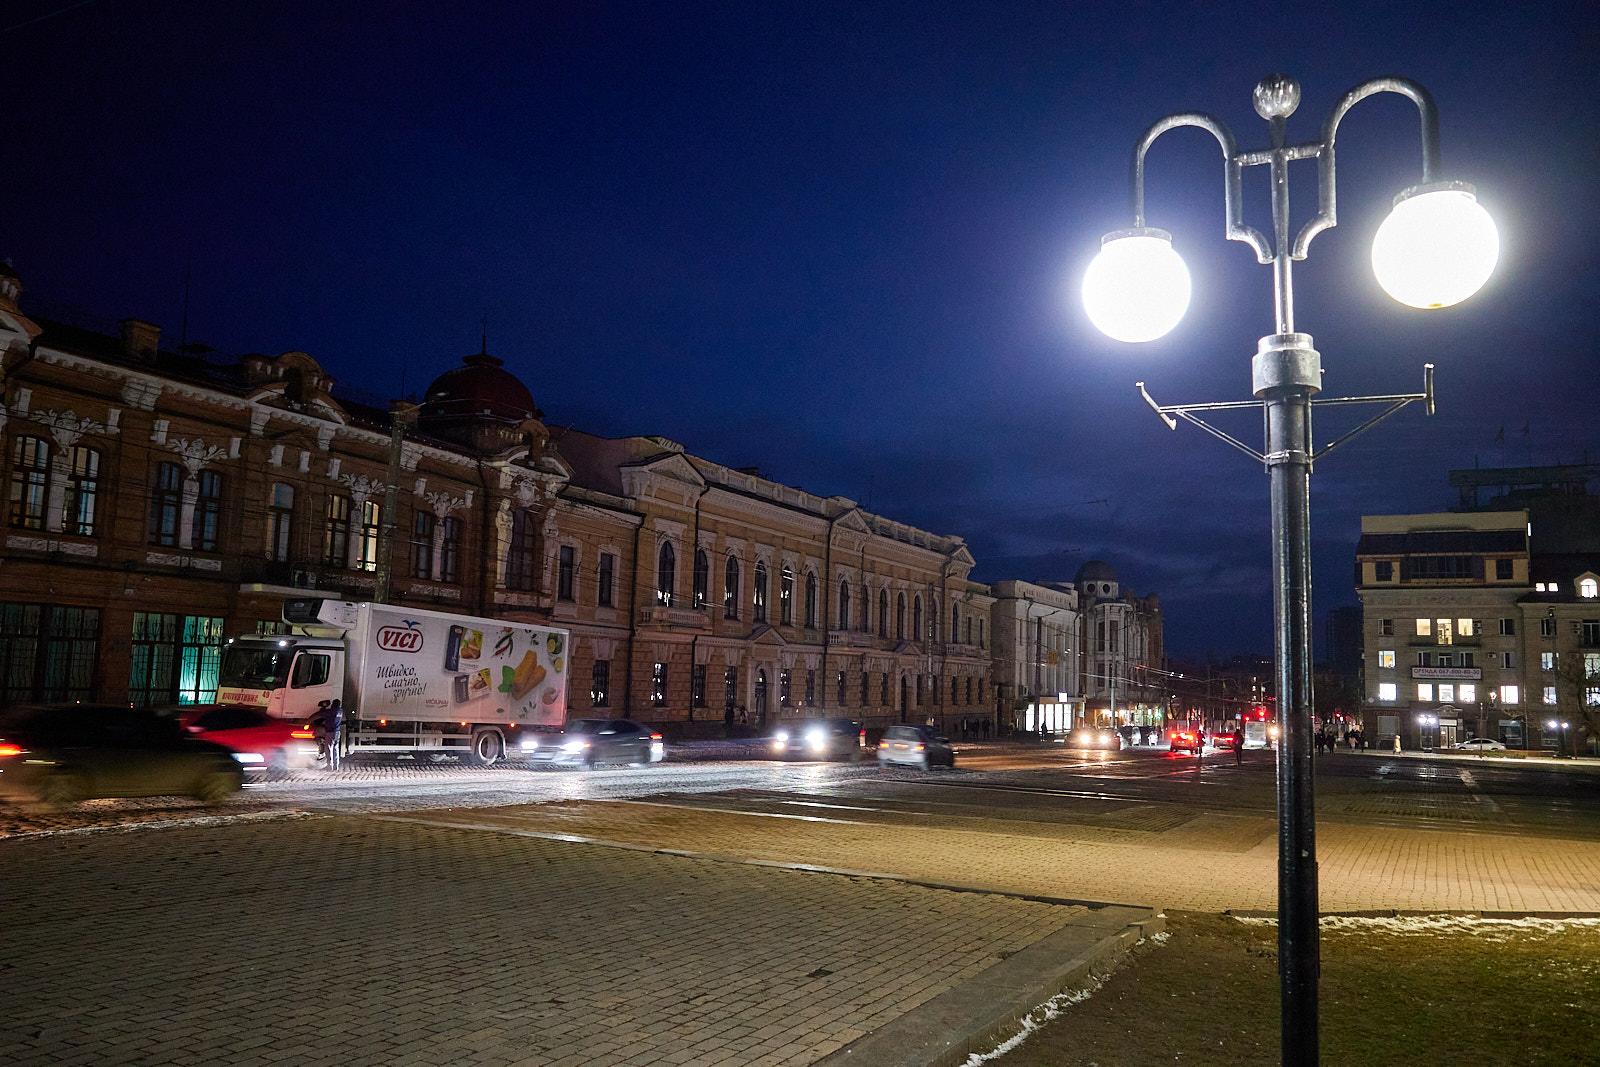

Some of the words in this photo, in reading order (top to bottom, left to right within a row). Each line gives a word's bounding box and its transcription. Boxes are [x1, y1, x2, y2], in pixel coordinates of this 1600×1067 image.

[383, 631, 419, 648] VICI
[377, 664, 416, 678] Швидко,
[385, 677, 420, 688] смачно,
[391, 683, 426, 703] зручно!
